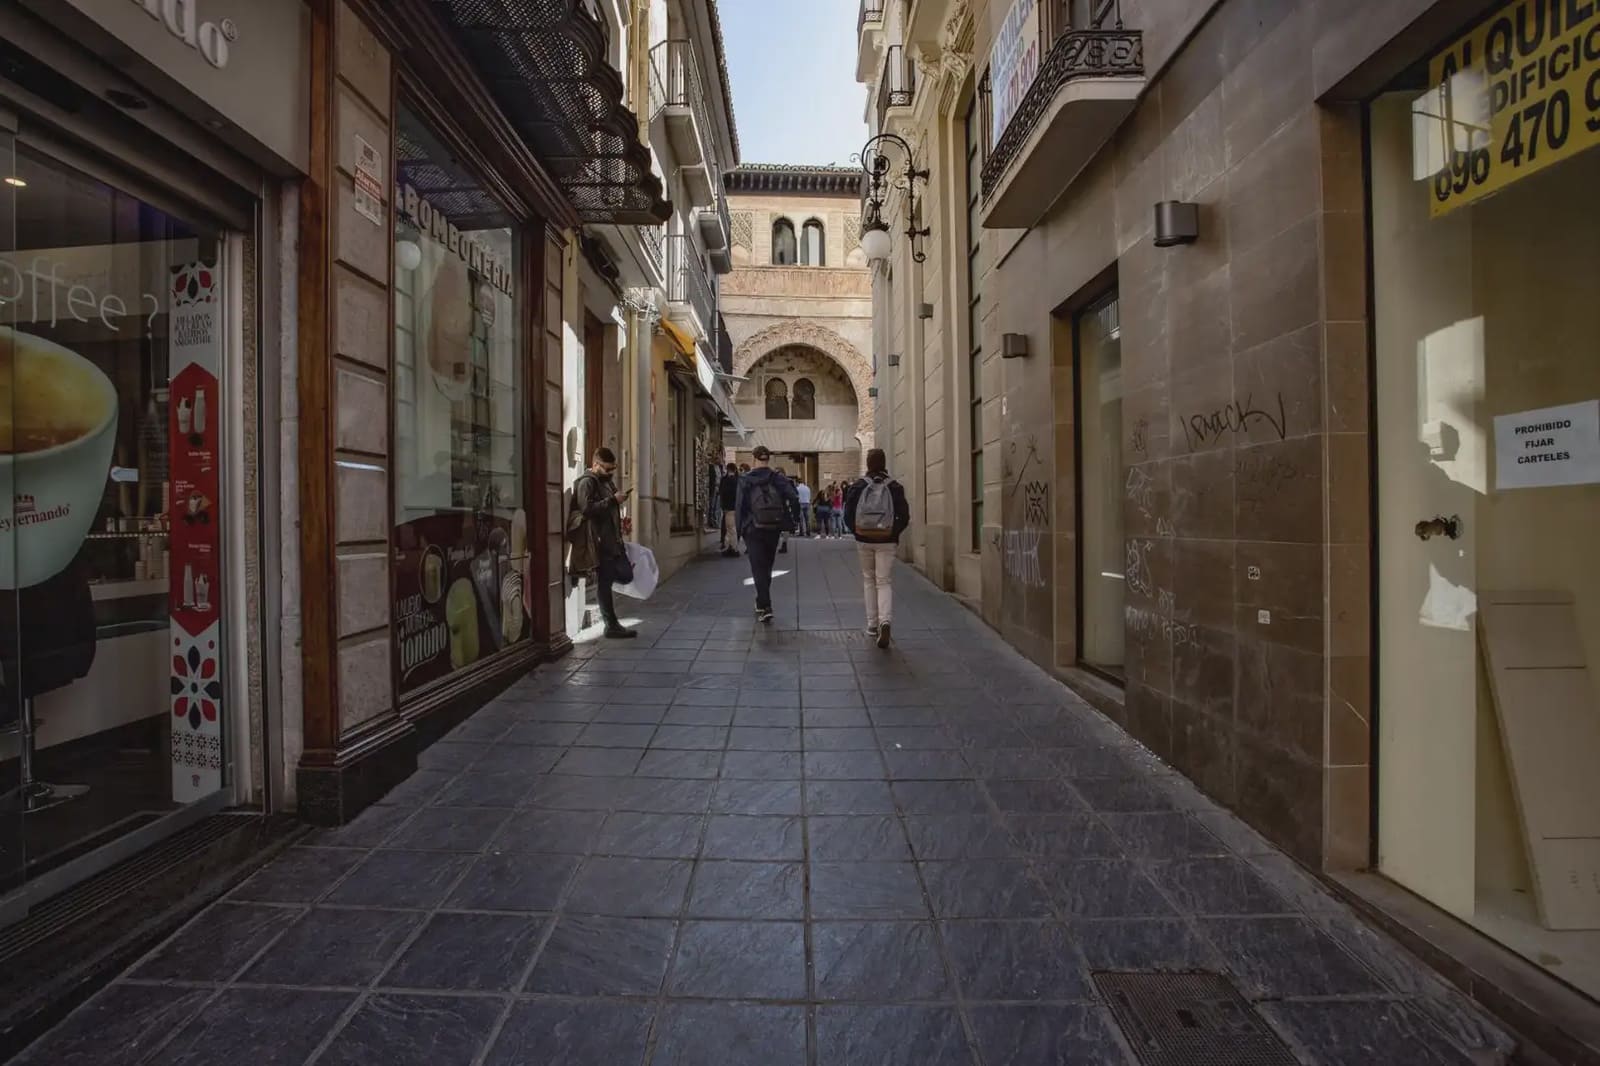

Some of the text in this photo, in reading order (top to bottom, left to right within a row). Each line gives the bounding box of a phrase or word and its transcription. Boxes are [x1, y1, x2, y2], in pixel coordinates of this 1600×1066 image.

[1501, 88, 1571, 168] 470
[1515, 420, 1571, 434] PROHIBIDO
[1525, 438, 1555, 448] FIJAR
[1517, 451, 1570, 464] CARTELES
